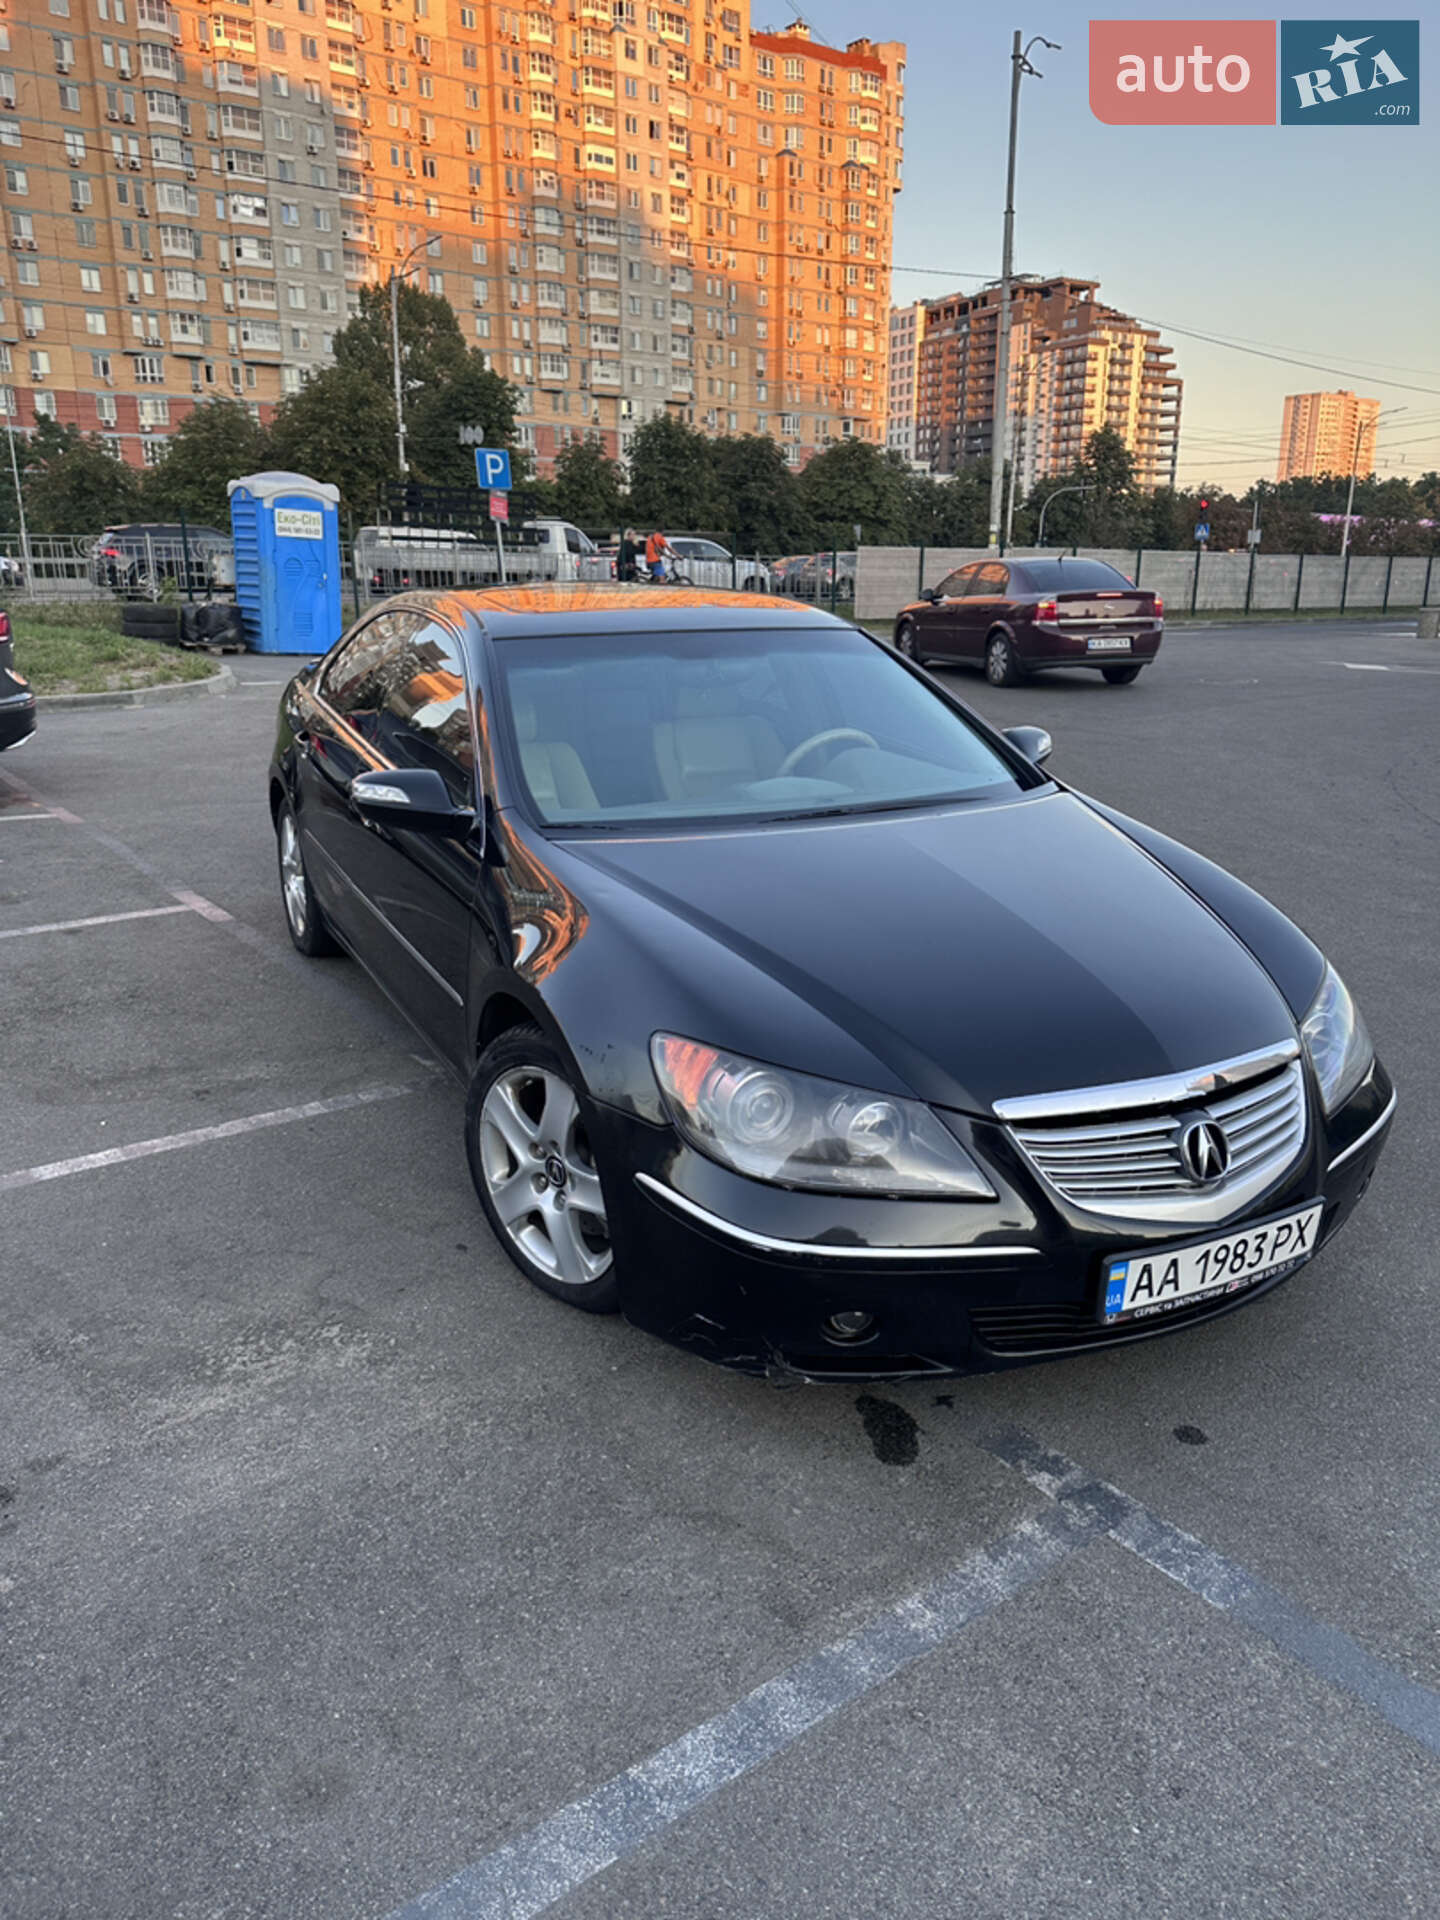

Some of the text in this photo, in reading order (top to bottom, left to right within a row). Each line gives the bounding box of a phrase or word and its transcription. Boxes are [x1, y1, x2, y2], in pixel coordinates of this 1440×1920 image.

[485, 453, 505, 485] P
[1130, 1214, 1314, 1302] AA 1983 PX
[1106, 1294, 1121, 1306] UA
[1134, 1303, 1163, 1318] СЕРВІС
